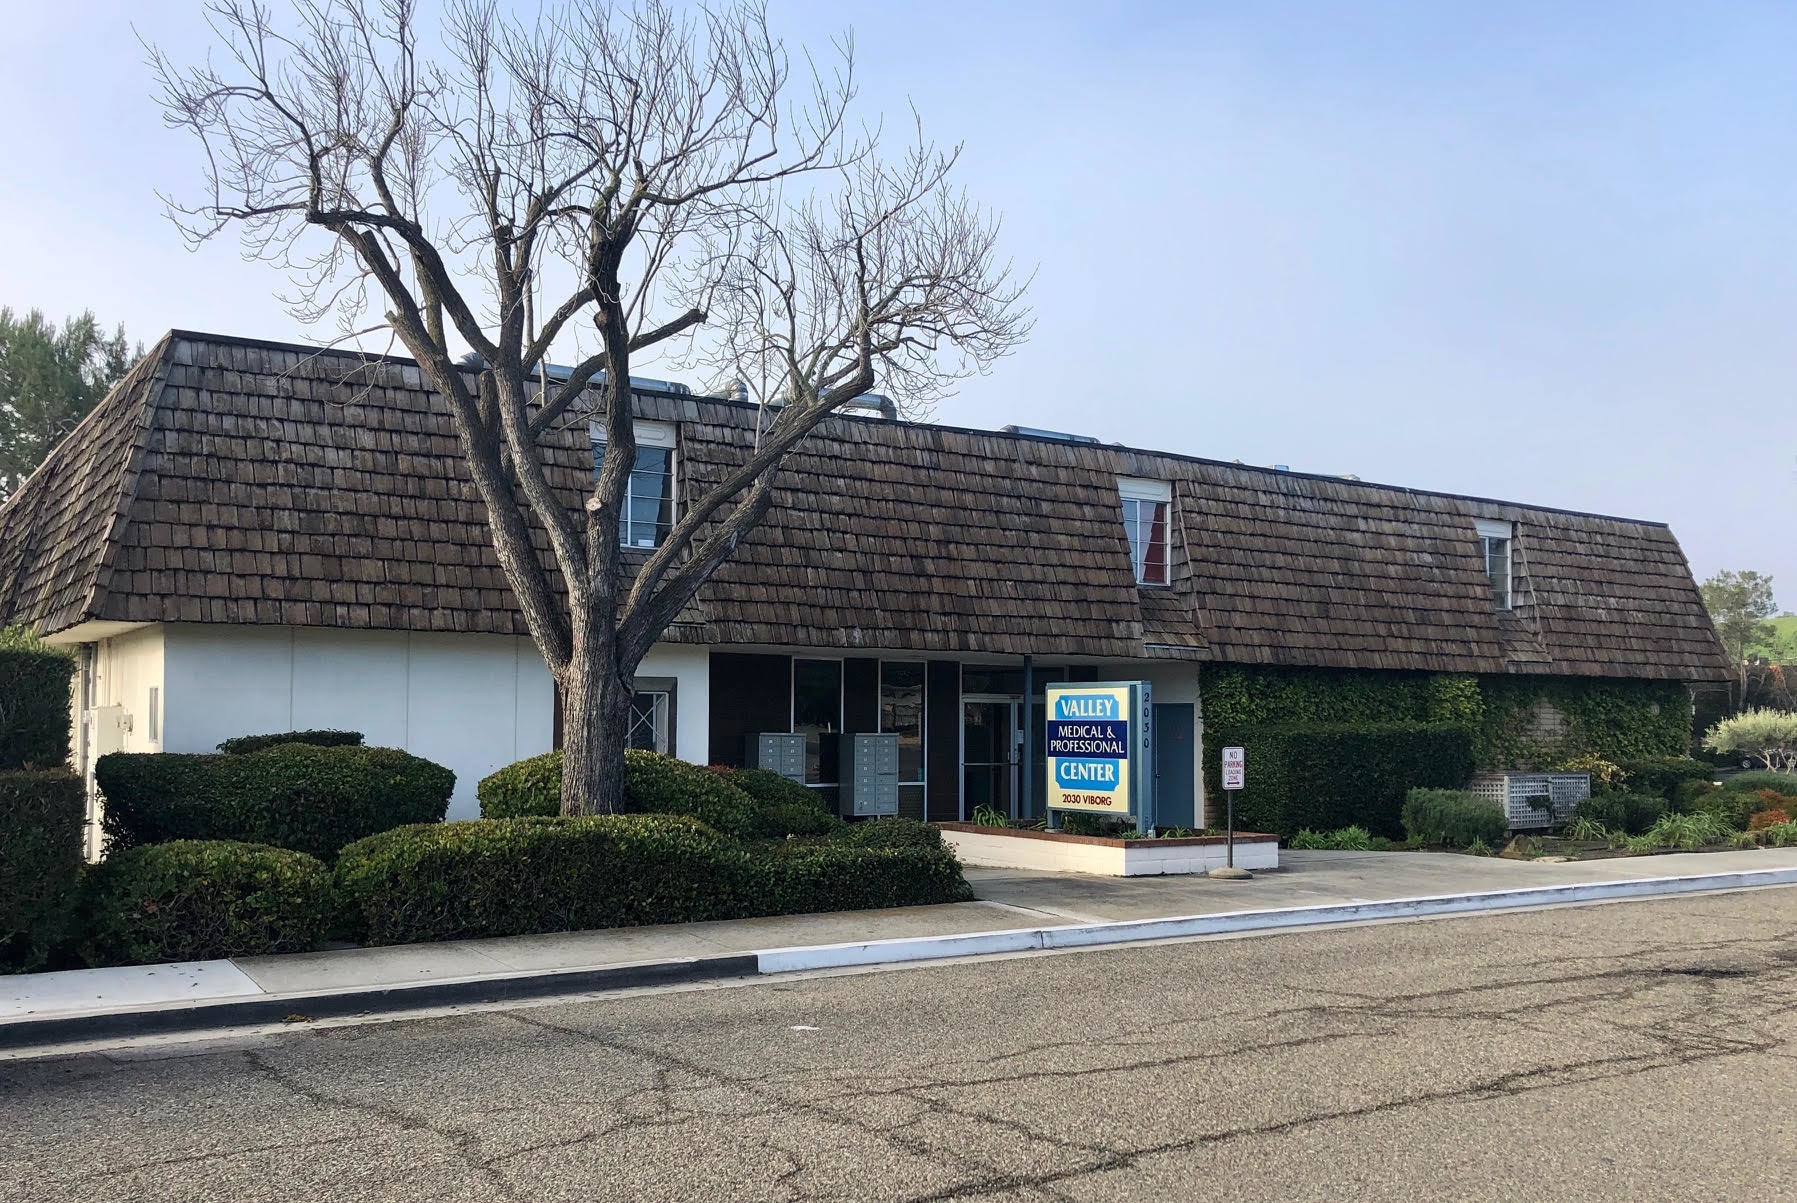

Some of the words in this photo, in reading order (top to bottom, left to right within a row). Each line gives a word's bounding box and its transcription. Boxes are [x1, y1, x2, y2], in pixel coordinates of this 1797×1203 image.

[1060, 699, 1113, 717] VALLEY
[1058, 725, 1103, 738] MEDICAL
[1106, 725, 1116, 738] &
[1050, 740, 1125, 753] PROFESSIONAL
[1229, 751, 1237, 759] NO
[1223, 760, 1243, 768] PARKING
[1060, 762, 1114, 781] CENTER
[1062, 794, 1081, 804] 2030
[1083, 795, 1112, 806] VIBORG
